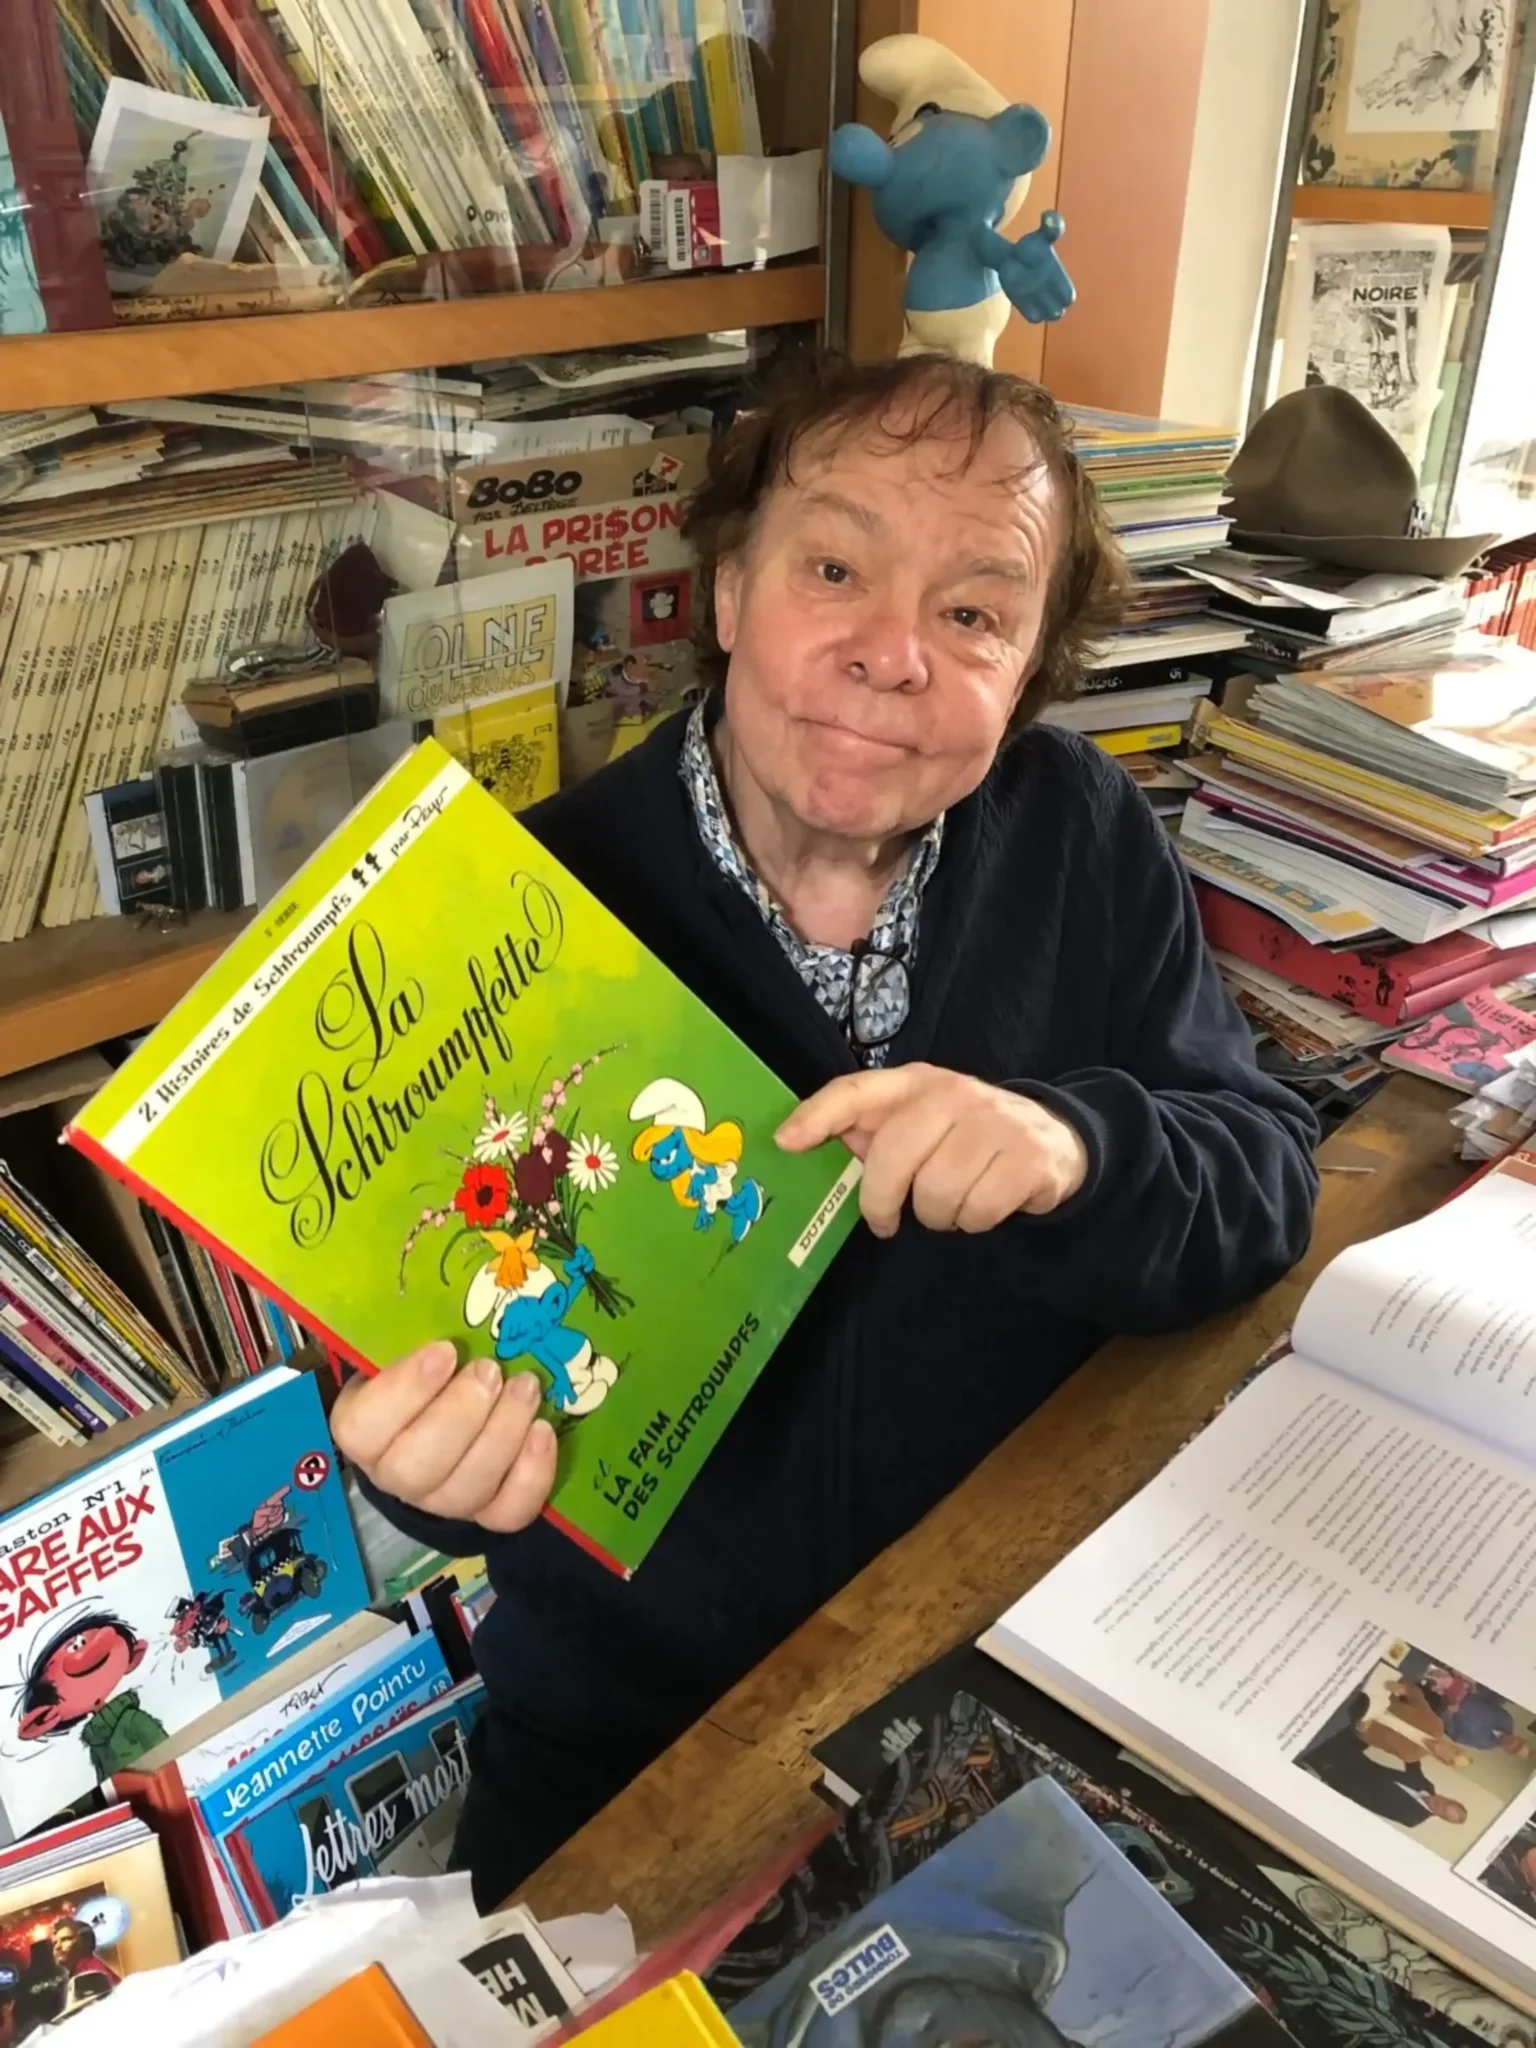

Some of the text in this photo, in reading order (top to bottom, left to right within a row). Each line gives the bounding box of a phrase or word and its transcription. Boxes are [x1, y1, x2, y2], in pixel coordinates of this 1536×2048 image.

[1352, 286, 1418, 302] NOIRE
[484, 523, 530, 559] LA
[138, 1102, 158, 1123] 2
[154, 1026, 231, 1105] Histoires
[231, 1000, 254, 1026] de
[254, 893, 353, 999] Schtroumpfs
[259, 869, 565, 1252] Schtroumpfette
[314, 918, 425, 1094] La
[797, 1181, 849, 1253] DUPUIS
[602, 1409, 673, 1508] LA FAIM
[622, 1311, 762, 1522] DES SCHTROUMPFS
[76, 1484, 156, 1554] AUX
[222, 1717, 344, 1818] Jeannette
[352, 1658, 427, 1725] Pointu
[291, 1799, 398, 1910] Lettres
